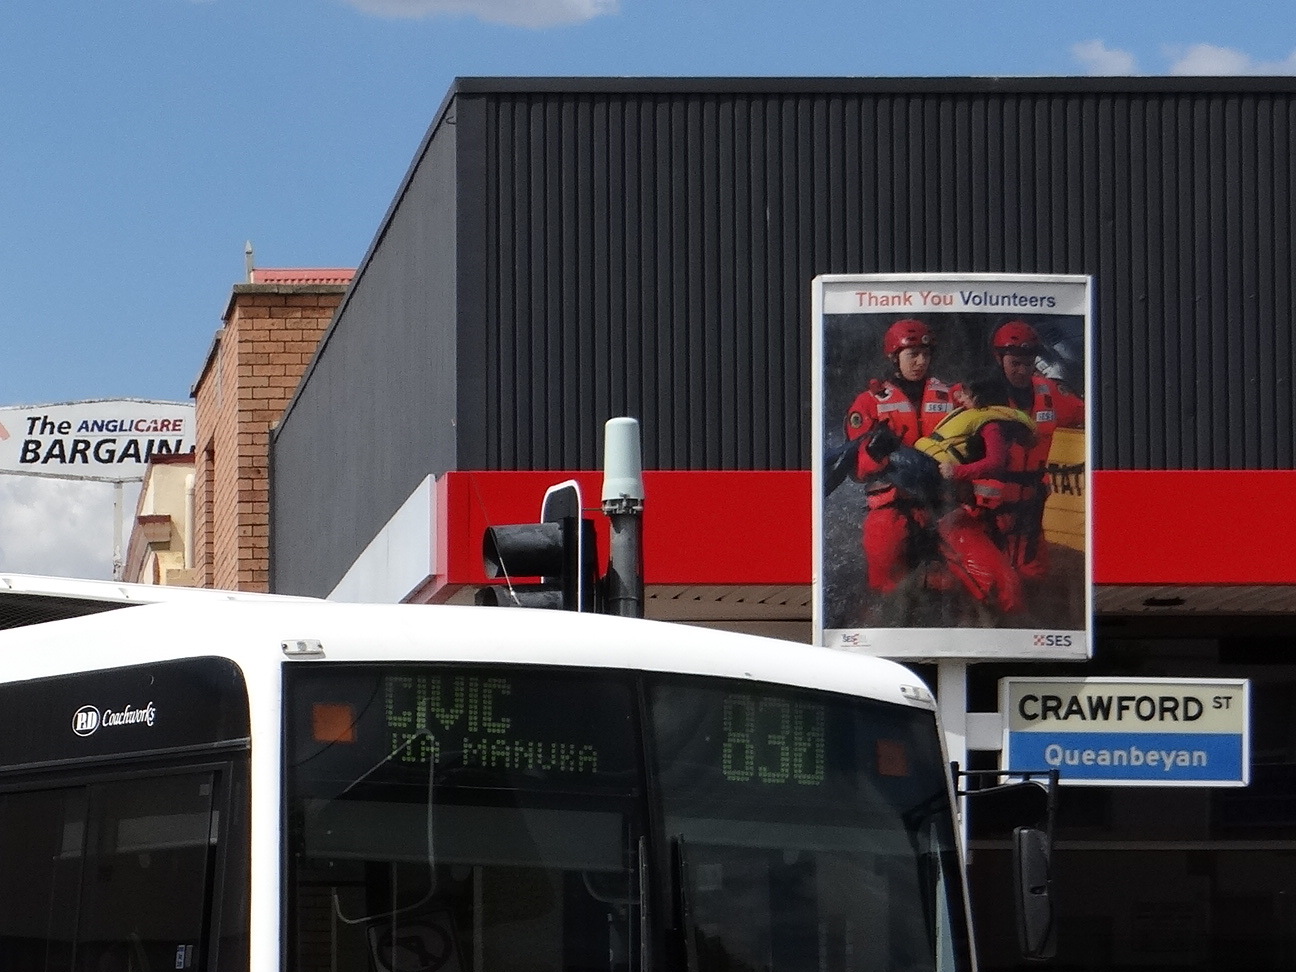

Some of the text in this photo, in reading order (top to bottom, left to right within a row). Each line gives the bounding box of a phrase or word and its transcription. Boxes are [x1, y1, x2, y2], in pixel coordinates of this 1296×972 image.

[855, 290, 1056, 308] Thank You Volunteers
[26, 415, 184, 436] The ANGLICARE
[19, 438, 183, 464] BARGAIN
[1045, 634, 1073, 647] SES
[102, 701, 157, 728] Coachworks
[384, 675, 512, 733] CIVIC
[1018, 694, 1233, 722] CRAWFORD ST
[462, 737, 599, 773] MANUKA
[1044, 744, 1208, 771] Queanbeyan
